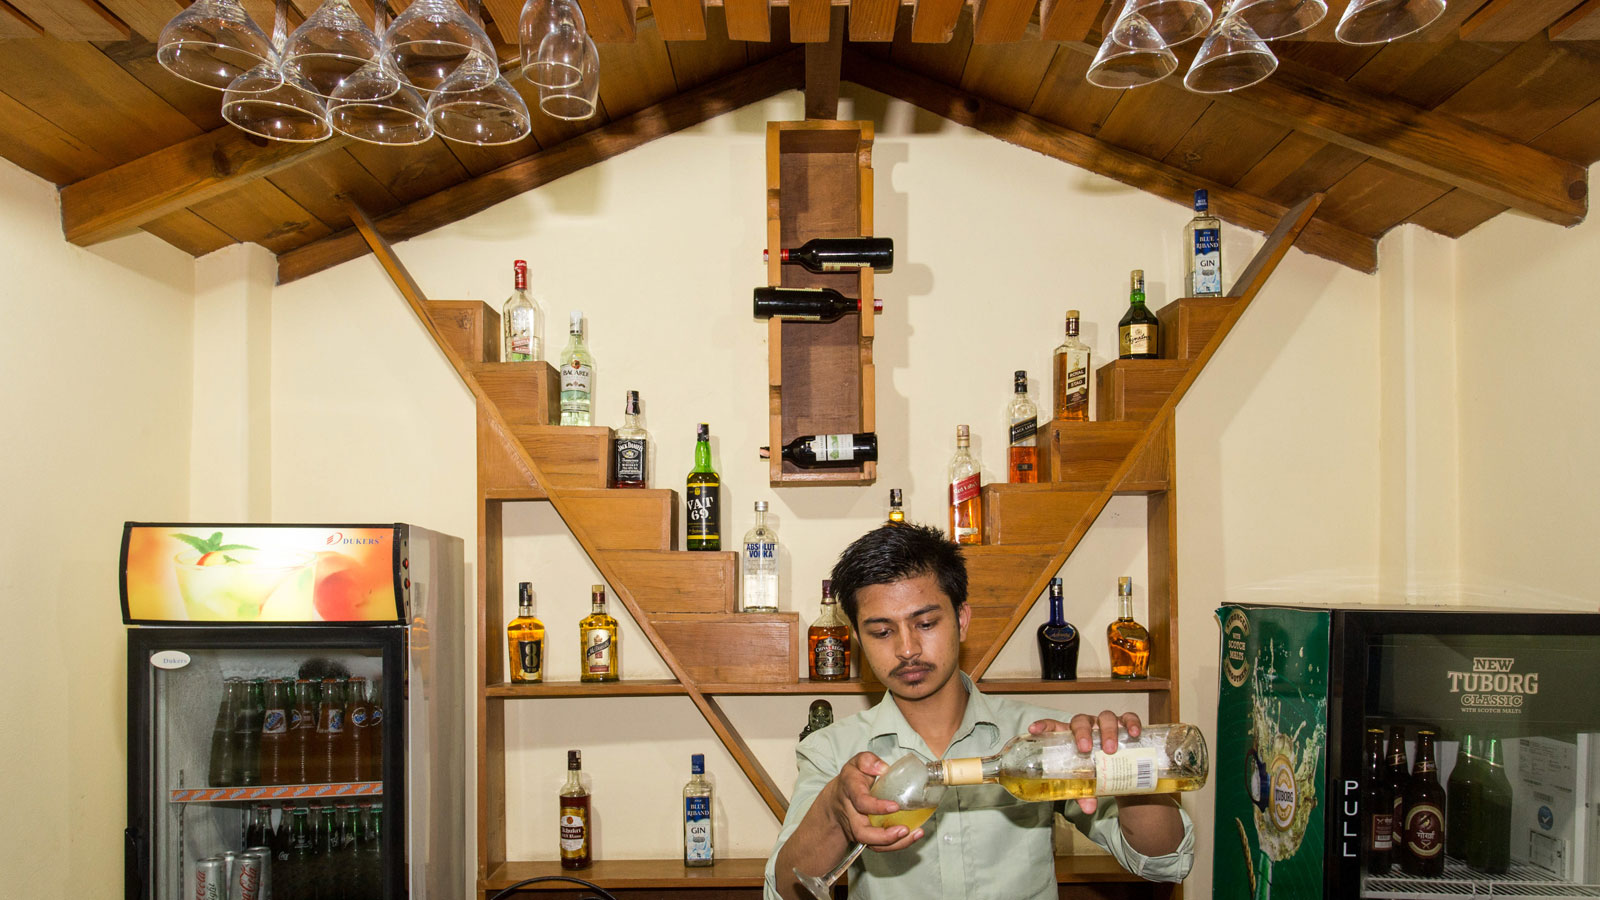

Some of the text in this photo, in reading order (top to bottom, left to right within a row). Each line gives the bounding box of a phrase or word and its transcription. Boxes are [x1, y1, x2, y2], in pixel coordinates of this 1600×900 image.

[686, 496, 714, 511] VAT
[343, 537, 380, 545] DUKERS
[746, 543, 775, 551] ABSOLUT
[1228, 640, 1246, 650] SCOTCH
[1474, 658, 1514, 672] NEW
[1448, 671, 1538, 694] TUBORG
[1461, 694, 1523, 707] CLASSIC
[1275, 789, 1294, 803] TUBORG
[1343, 780, 1359, 857] PULL
